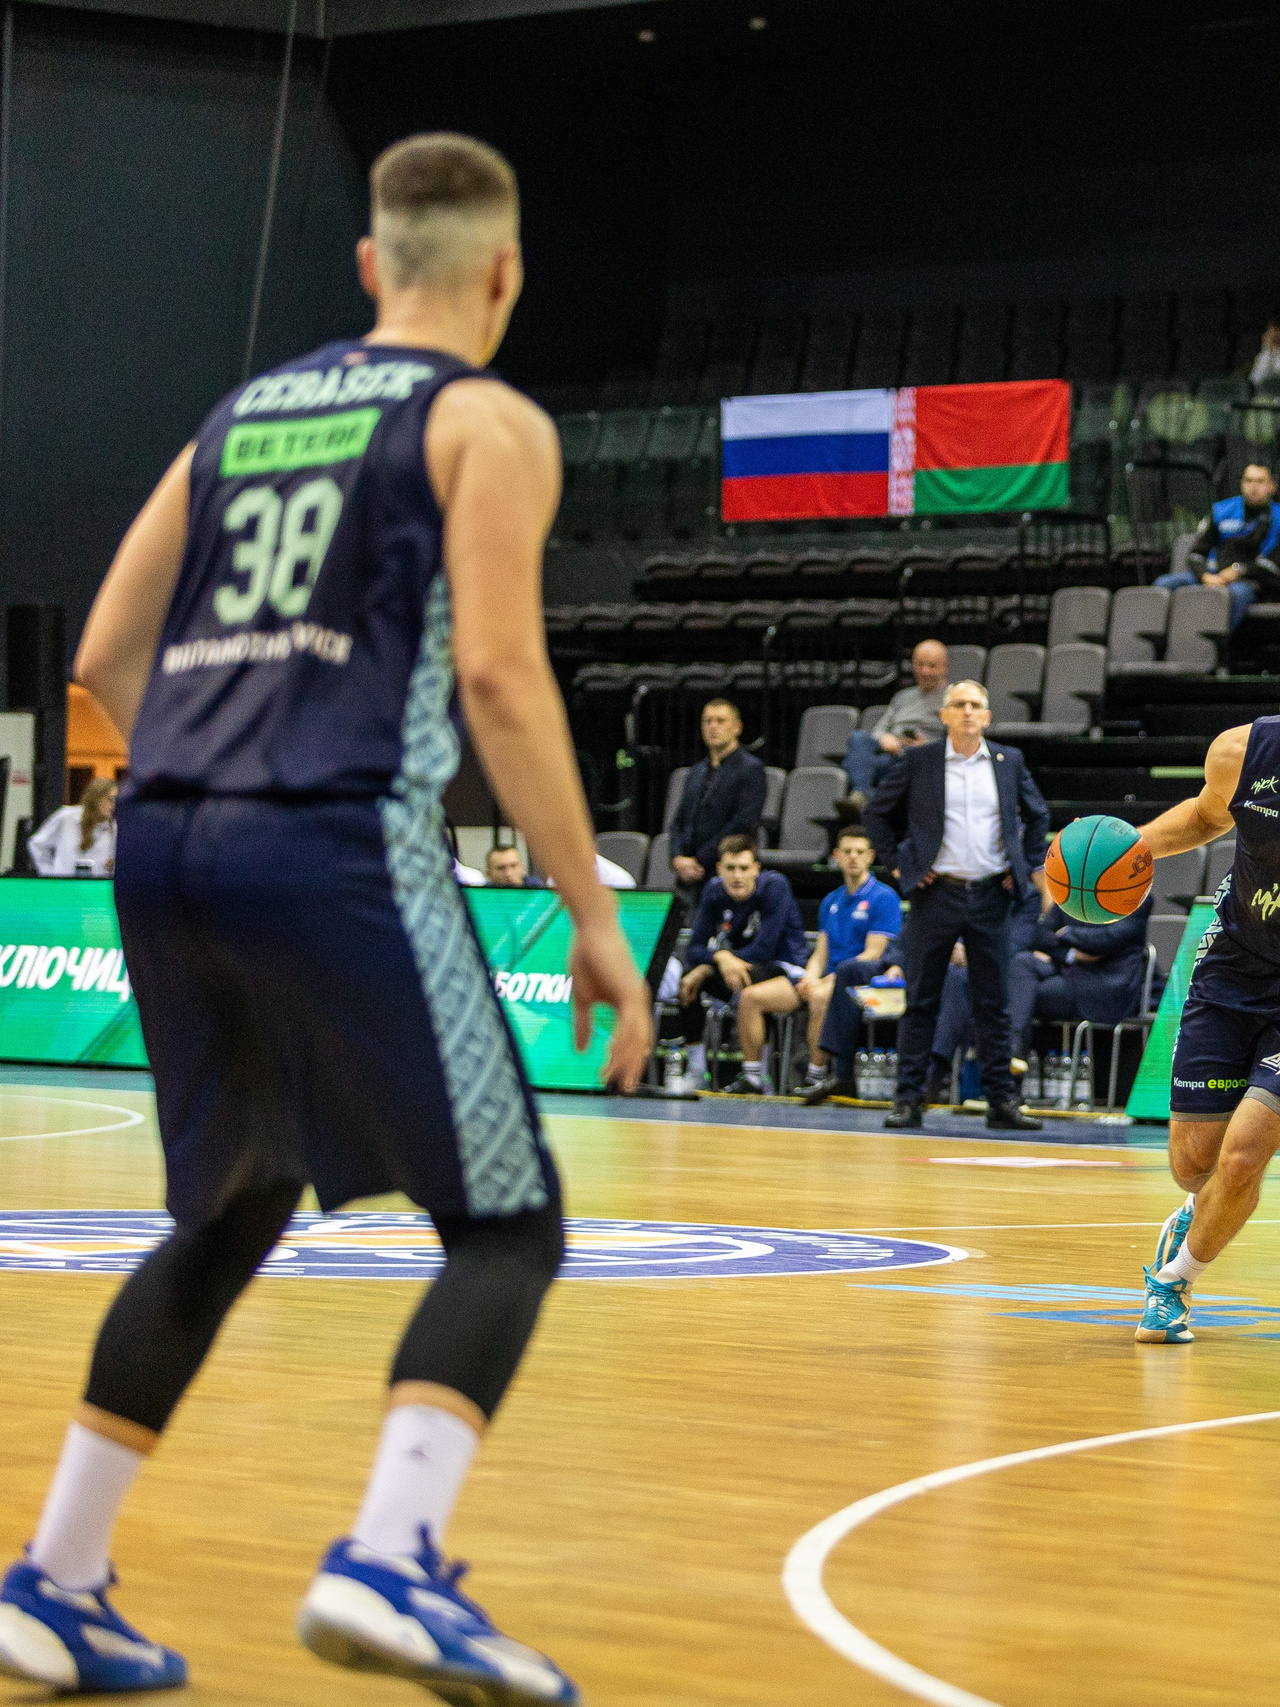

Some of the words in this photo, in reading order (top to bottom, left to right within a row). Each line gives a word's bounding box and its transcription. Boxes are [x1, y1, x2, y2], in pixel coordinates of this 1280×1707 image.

[213, 477, 344, 626] 38
[1243, 800, 1279, 818] Kempa
[1173, 1076, 1205, 1091] Kempa
